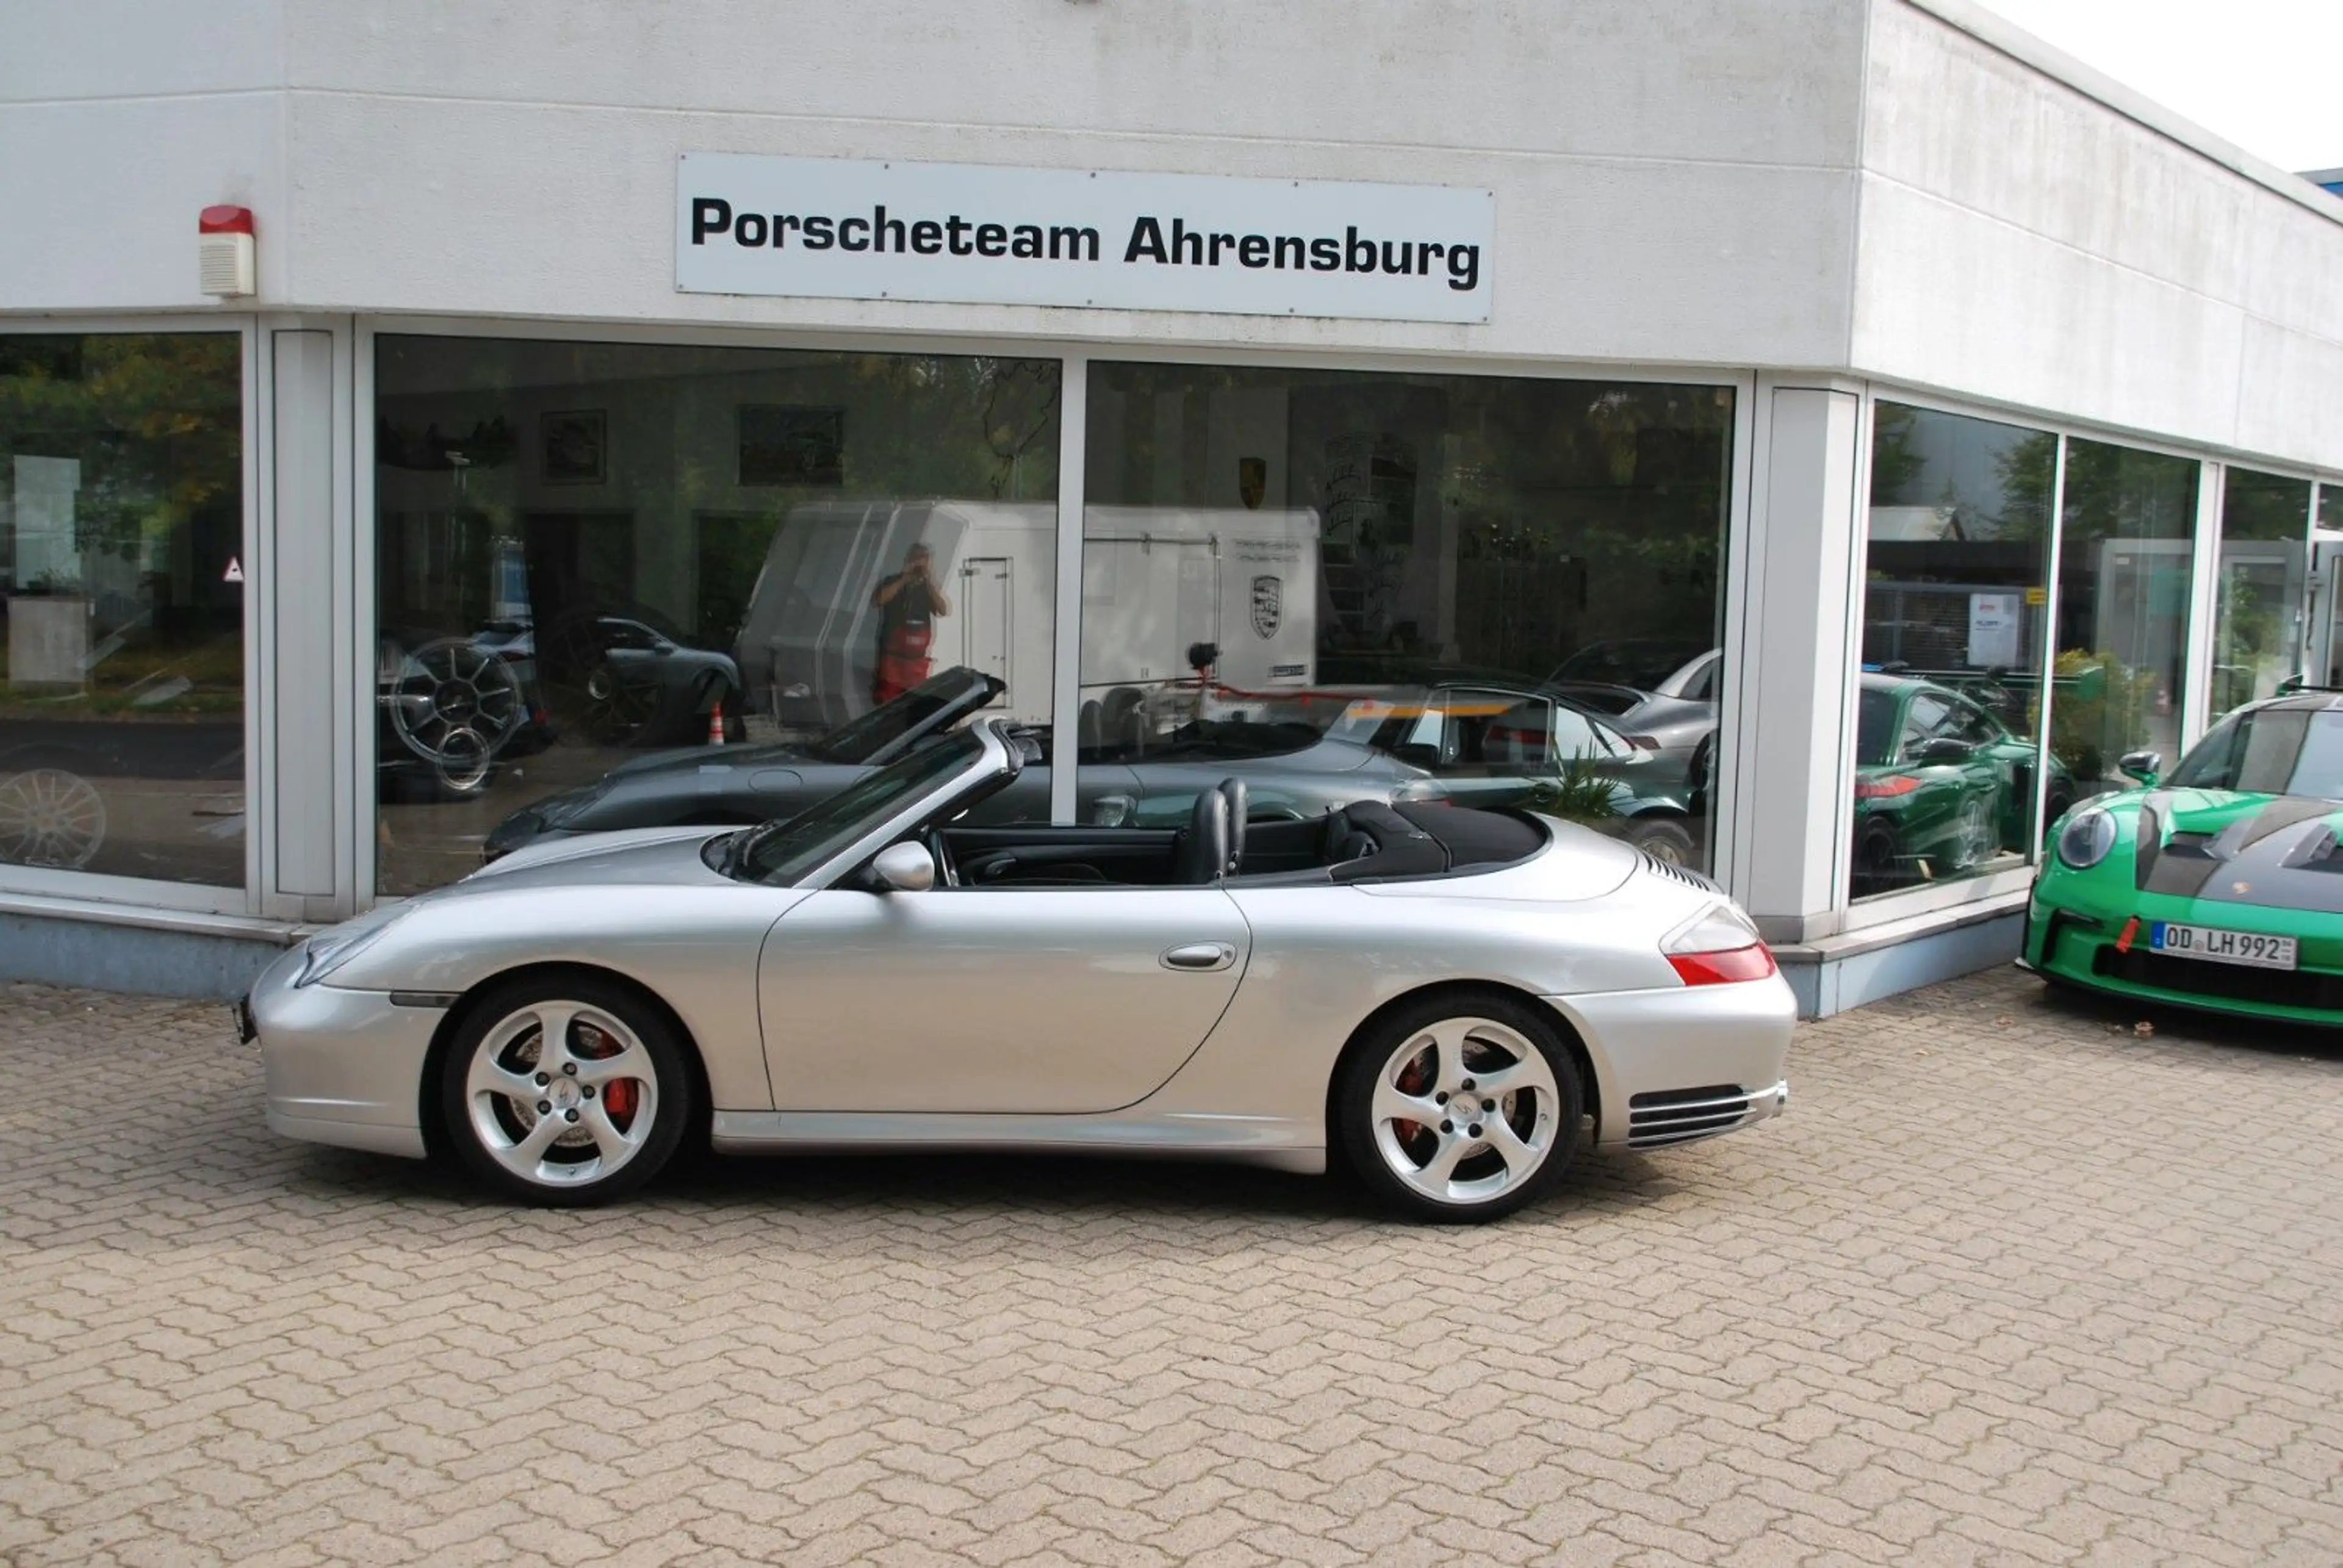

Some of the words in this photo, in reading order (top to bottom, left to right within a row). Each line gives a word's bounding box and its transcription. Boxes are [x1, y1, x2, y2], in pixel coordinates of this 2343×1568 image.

[692, 198, 1100, 261] Porscheteam
[1124, 217, 1480, 291] Ahrensburg
[2166, 927, 2193, 949] OD
[2207, 932, 2235, 954] LH
[2240, 935, 2280, 960] 992
